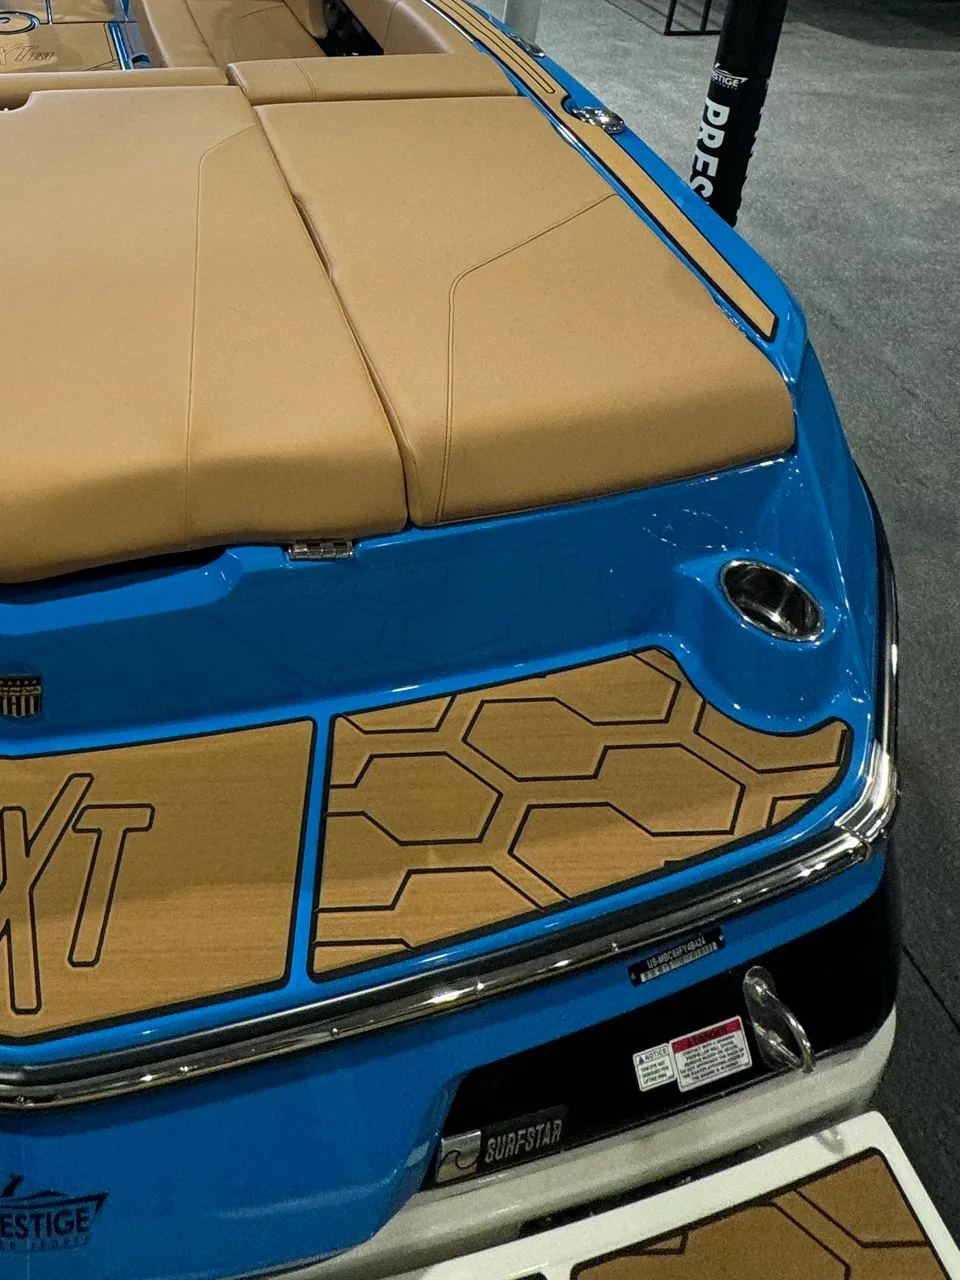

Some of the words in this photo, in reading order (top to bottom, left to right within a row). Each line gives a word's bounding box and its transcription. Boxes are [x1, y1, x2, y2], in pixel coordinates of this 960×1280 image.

[690, 97, 730, 204] PRES
[644, 1048, 668, 1061] NOTICE
[484, 1120, 563, 1164] SURFSTAR
